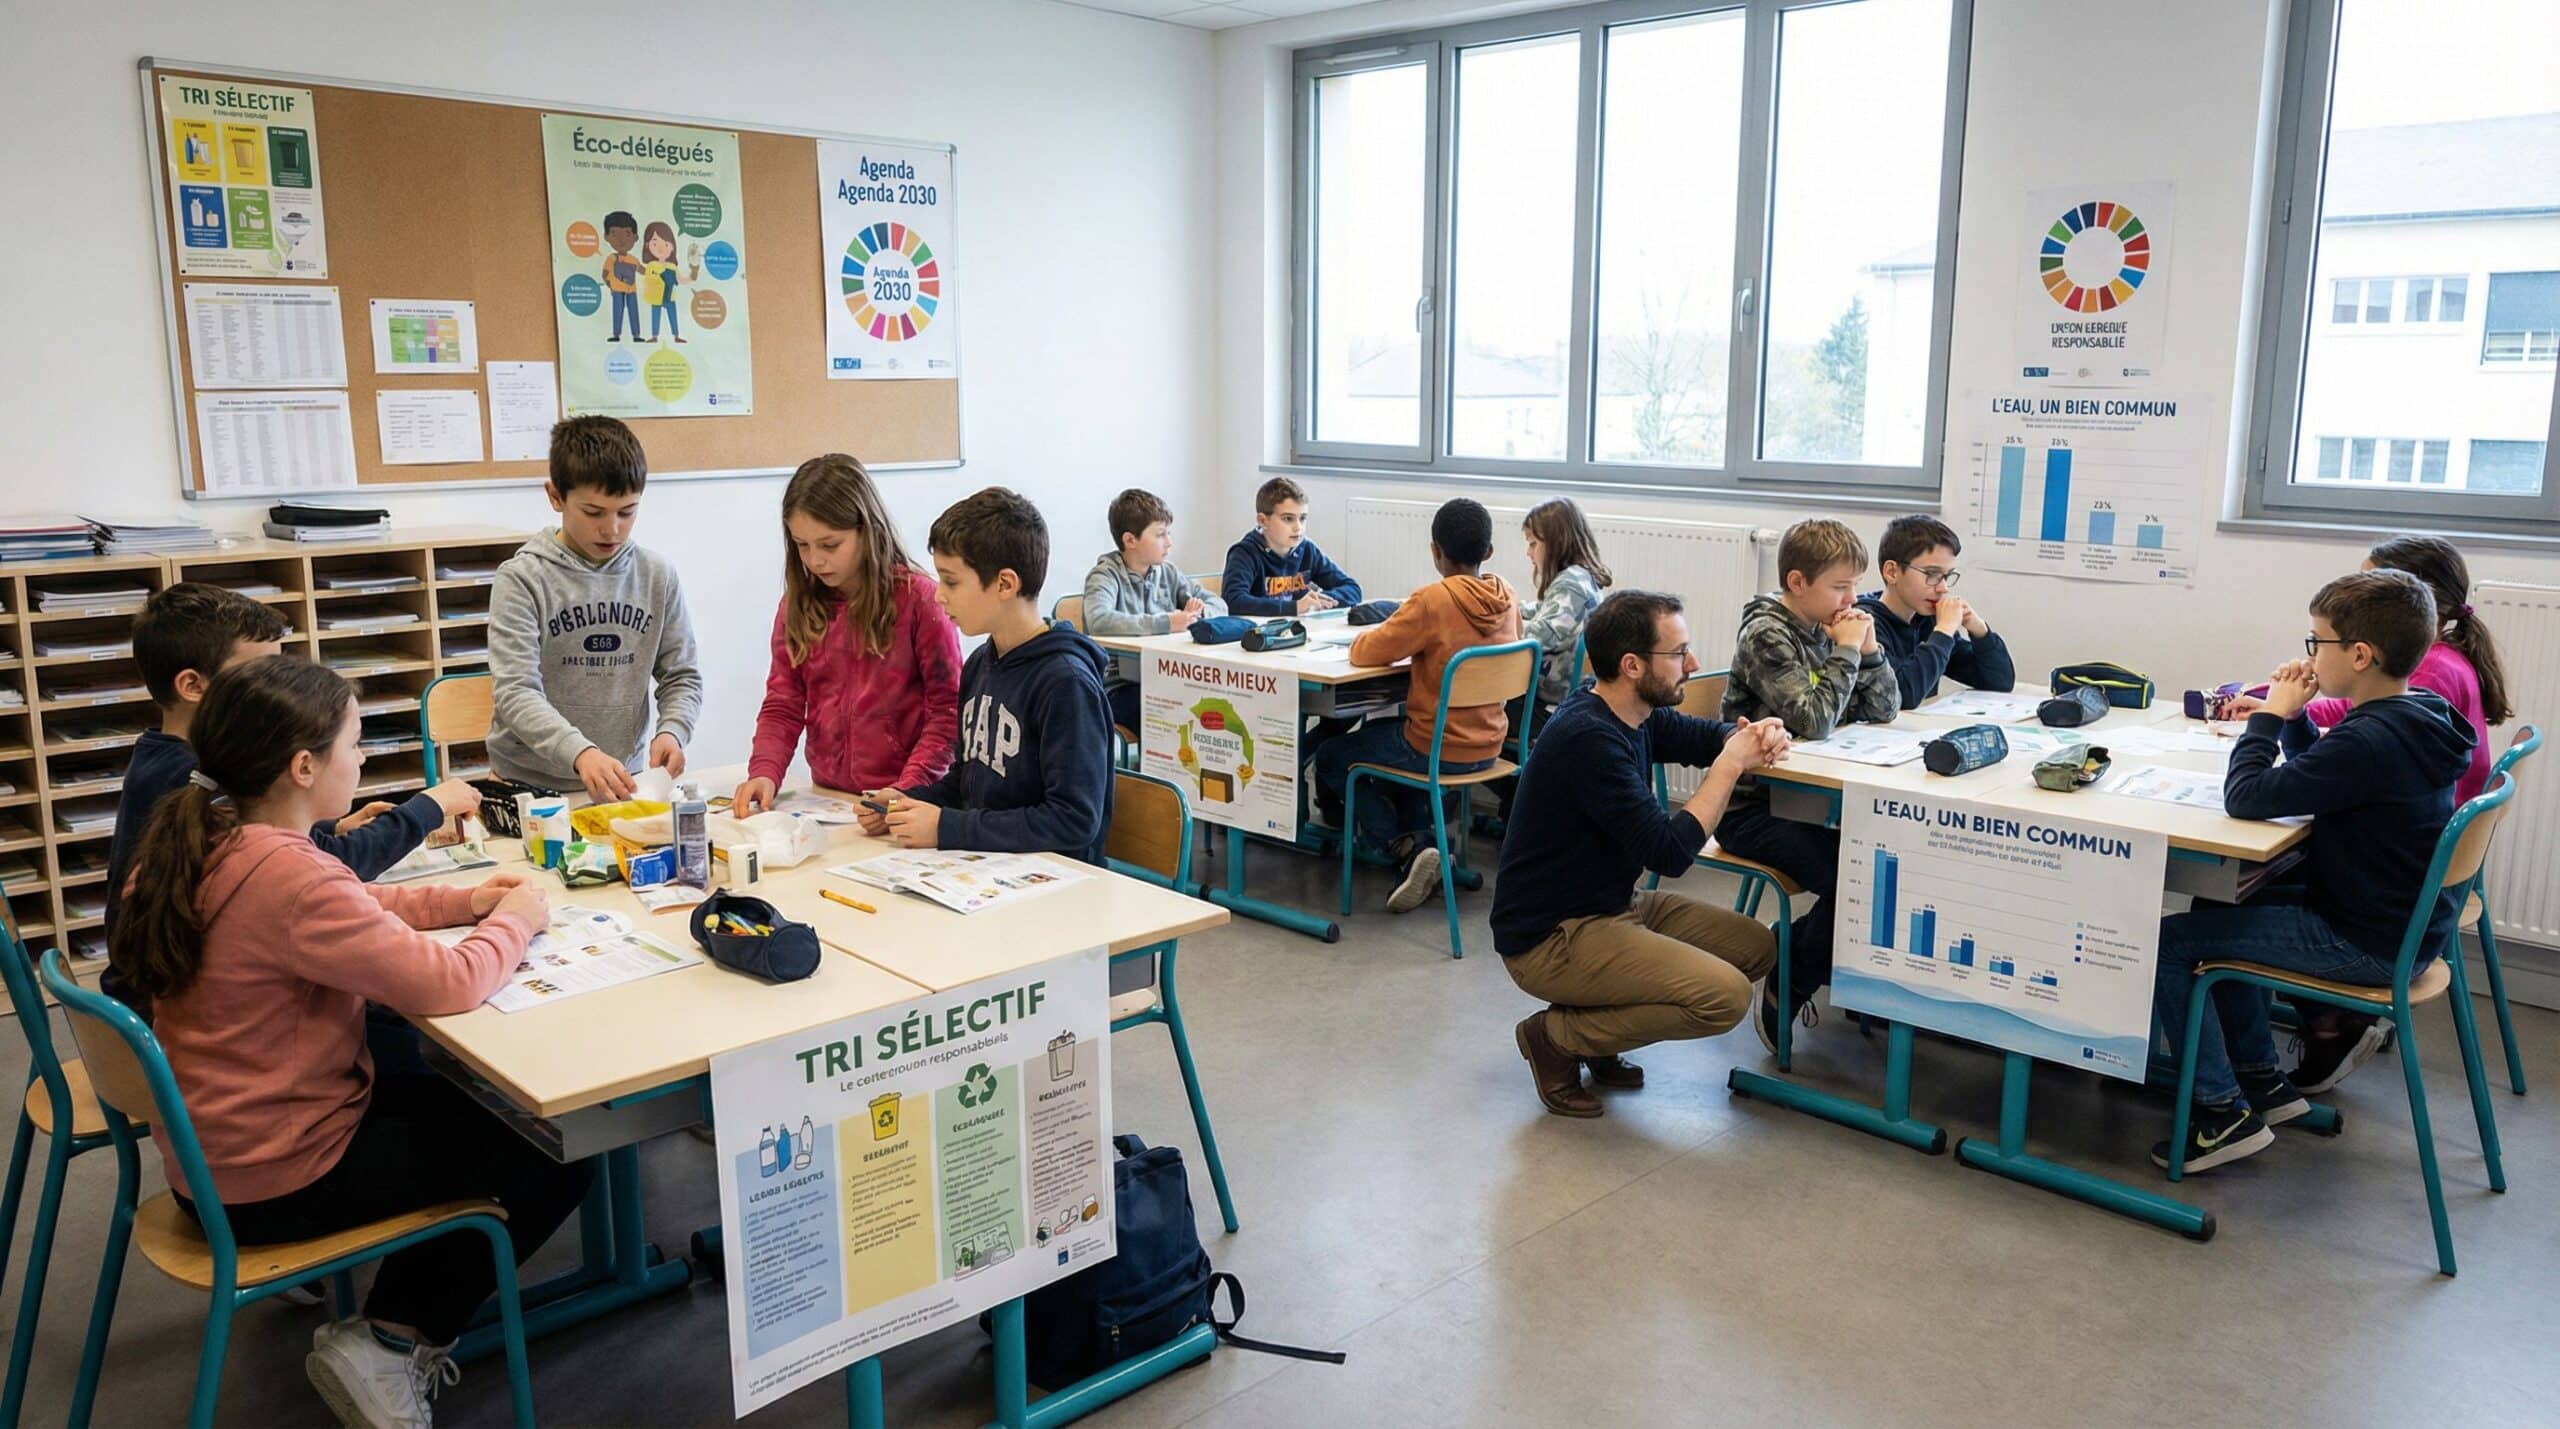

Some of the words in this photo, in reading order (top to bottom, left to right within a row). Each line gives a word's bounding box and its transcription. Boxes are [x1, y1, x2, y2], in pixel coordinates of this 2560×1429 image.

[179, 86, 210, 105] TRI
[215, 86, 295, 113] SÉLECTIF
[573, 126, 714, 165] Éco-délégués
[860, 155, 914, 182] Agenda
[838, 178, 894, 205] Agenda
[899, 184, 937, 206] 2030
[873, 281, 911, 301] 2030
[1992, 398, 2034, 416] L'EAU,
[2040, 399, 2060, 414] UN
[2065, 400, 2099, 415] BIEN
[2105, 400, 2176, 417] COMMUN
[1158, 658, 1222, 685] MANGER
[1226, 669, 1277, 695] MIEUX
[962, 694, 1021, 778] GAP
[1873, 798, 1931, 826] L'EAU,
[1937, 809, 1966, 829] UN
[1973, 815, 2020, 839] BIEN
[2027, 825, 2132, 860] COMMUN
[795, 1035, 864, 1084] TRI
[877, 980, 1046, 1061] SÉLECTIF
[840, 1075, 853, 1092] Le
